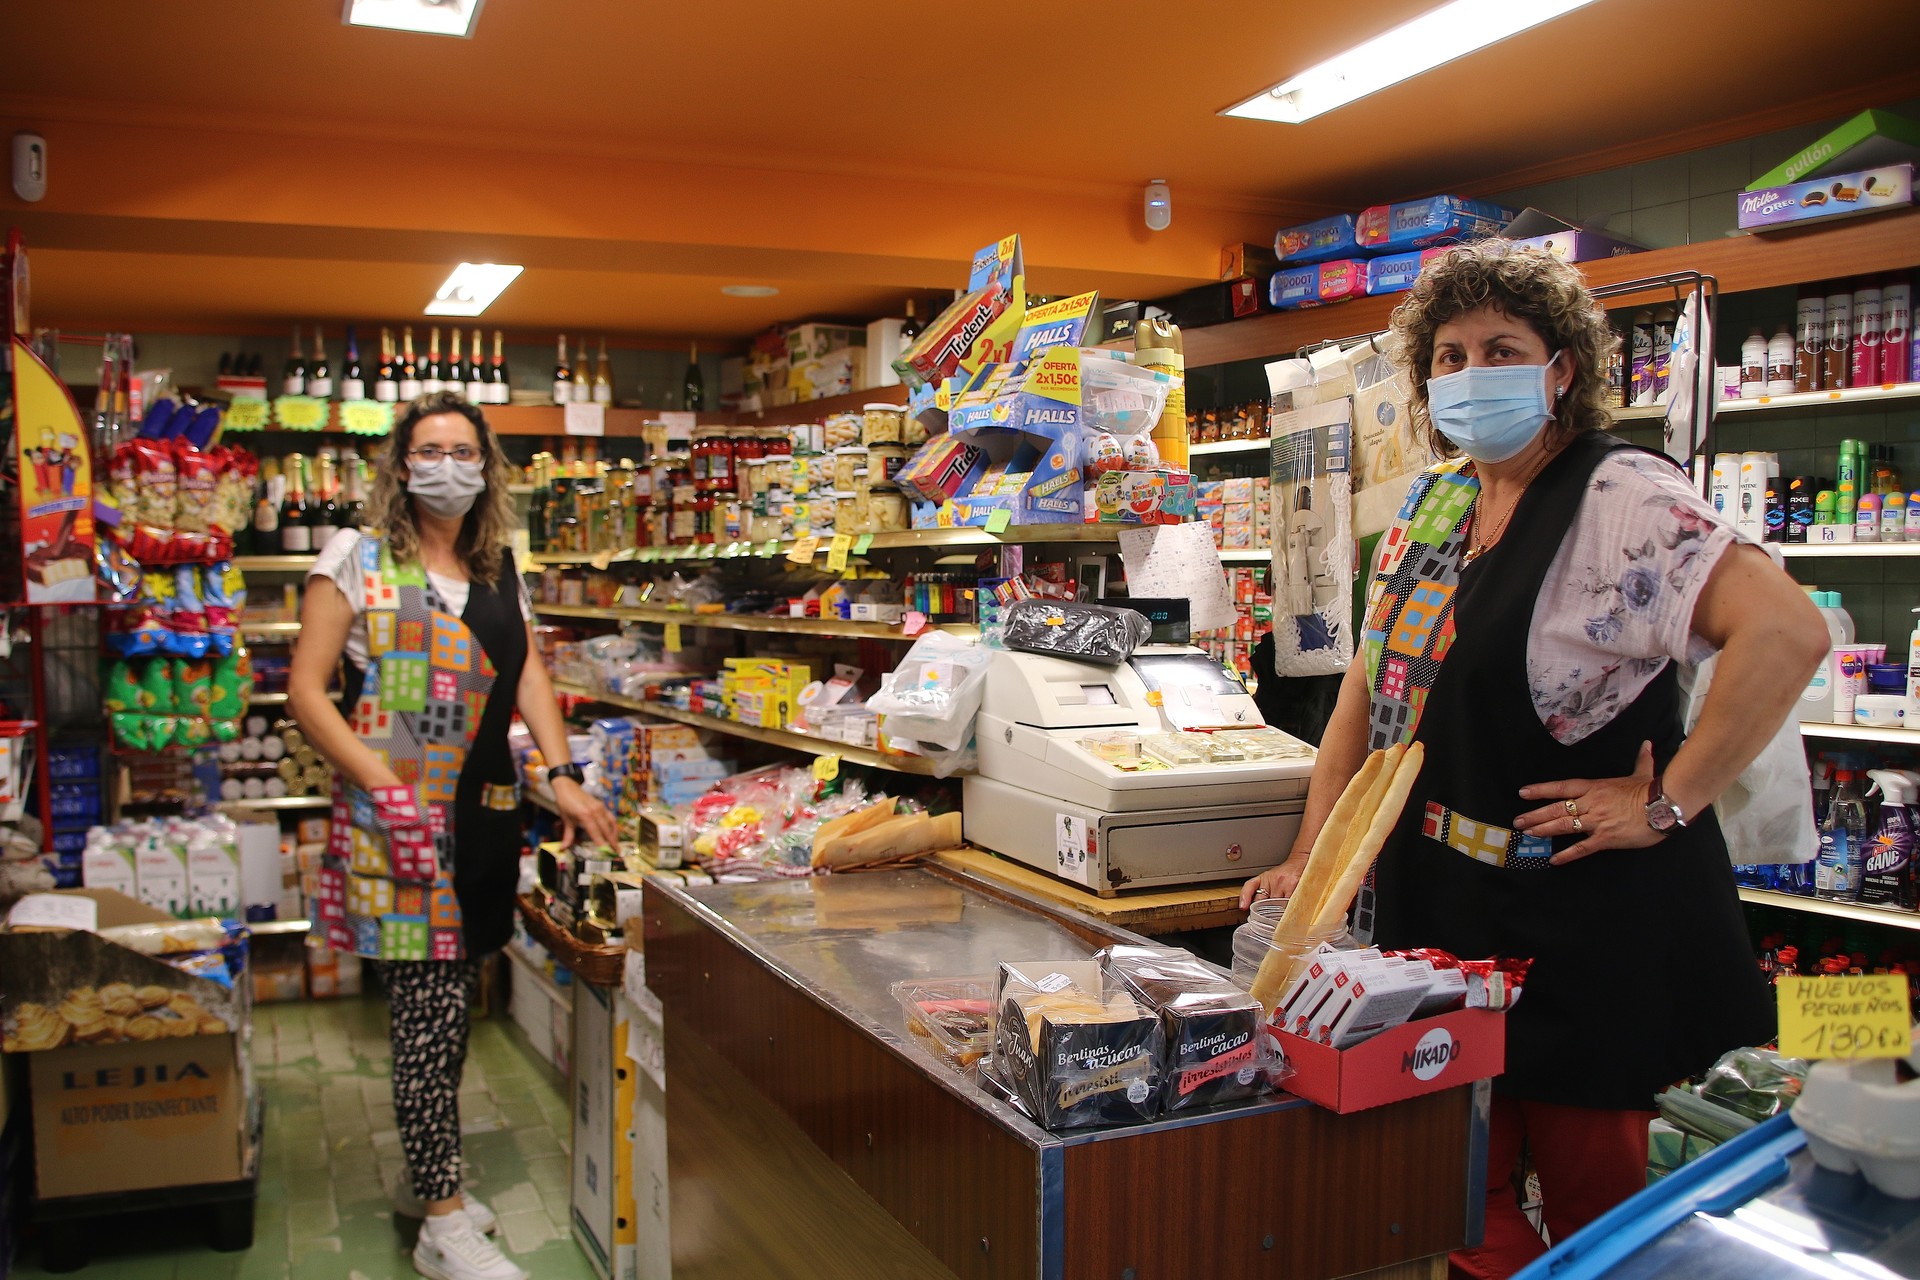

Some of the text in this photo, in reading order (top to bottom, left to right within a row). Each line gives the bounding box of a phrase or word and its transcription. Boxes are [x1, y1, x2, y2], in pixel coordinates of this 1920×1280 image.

[1785, 142, 1832, 182] gullón
[1741, 192, 1779, 214] Milka
[1761, 199, 1796, 215] OREO
[1380, 260, 1413, 274] DODOT
[1283, 274, 1313, 288] DODOT
[1026, 305, 1057, 322] OFERTA
[935, 305, 994, 366] Trident
[1024, 323, 1073, 352] HALLS
[1043, 361, 1078, 371] OFERTA
[1036, 373, 1078, 385] 2x1,50€
[967, 409, 991, 423] HALLS
[1024, 409, 1077, 425] HALLS
[937, 444, 980, 488] Tride
[1839, 465, 1853, 480] Fa
[1041, 475, 1069, 494] HALLS
[1038, 498, 1069, 510] HALLS
[1822, 527, 1834, 541] Fa
[1150, 612, 1169, 620] 2.00
[1866, 850, 1900, 872] BANG
[1797, 981, 1892, 999] HUEVOS
[1801, 997, 1904, 1017] PEQUEÑOS
[1009, 1032, 1034, 1069] Juan
[1180, 1032, 1226, 1055] Berlinas
[1211, 1031, 1249, 1056] cacao
[1058, 1045, 1110, 1066] Berlinas
[1088, 1043, 1142, 1070] azúcar
[1401, 1040, 1461, 1073] MIKADO
[62, 1062, 209, 1090] LEJIA
[61, 1095, 218, 1125] ALTO PODER DESINFECTANTE
